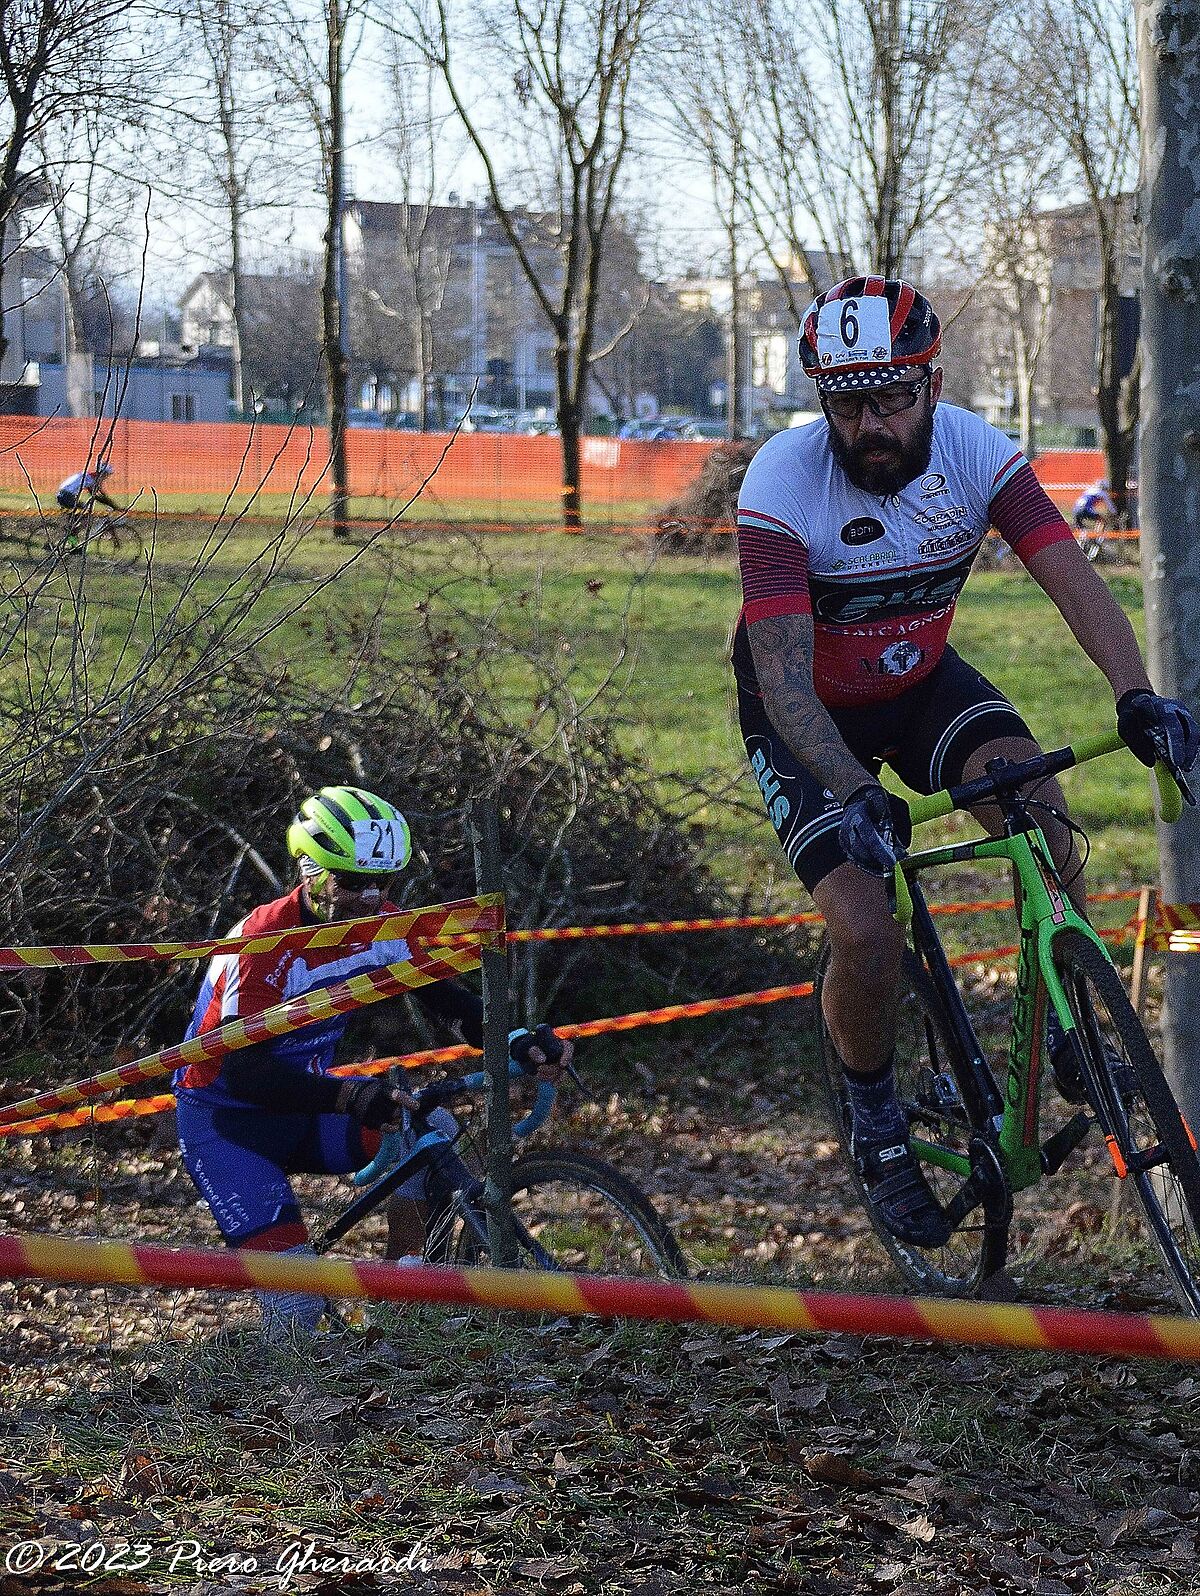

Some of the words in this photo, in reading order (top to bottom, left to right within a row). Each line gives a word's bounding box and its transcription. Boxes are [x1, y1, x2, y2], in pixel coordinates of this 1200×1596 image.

[841, 299, 859, 348] 6
[370, 821, 395, 859] 21
[879, 1144, 907, 1162] SIDI
